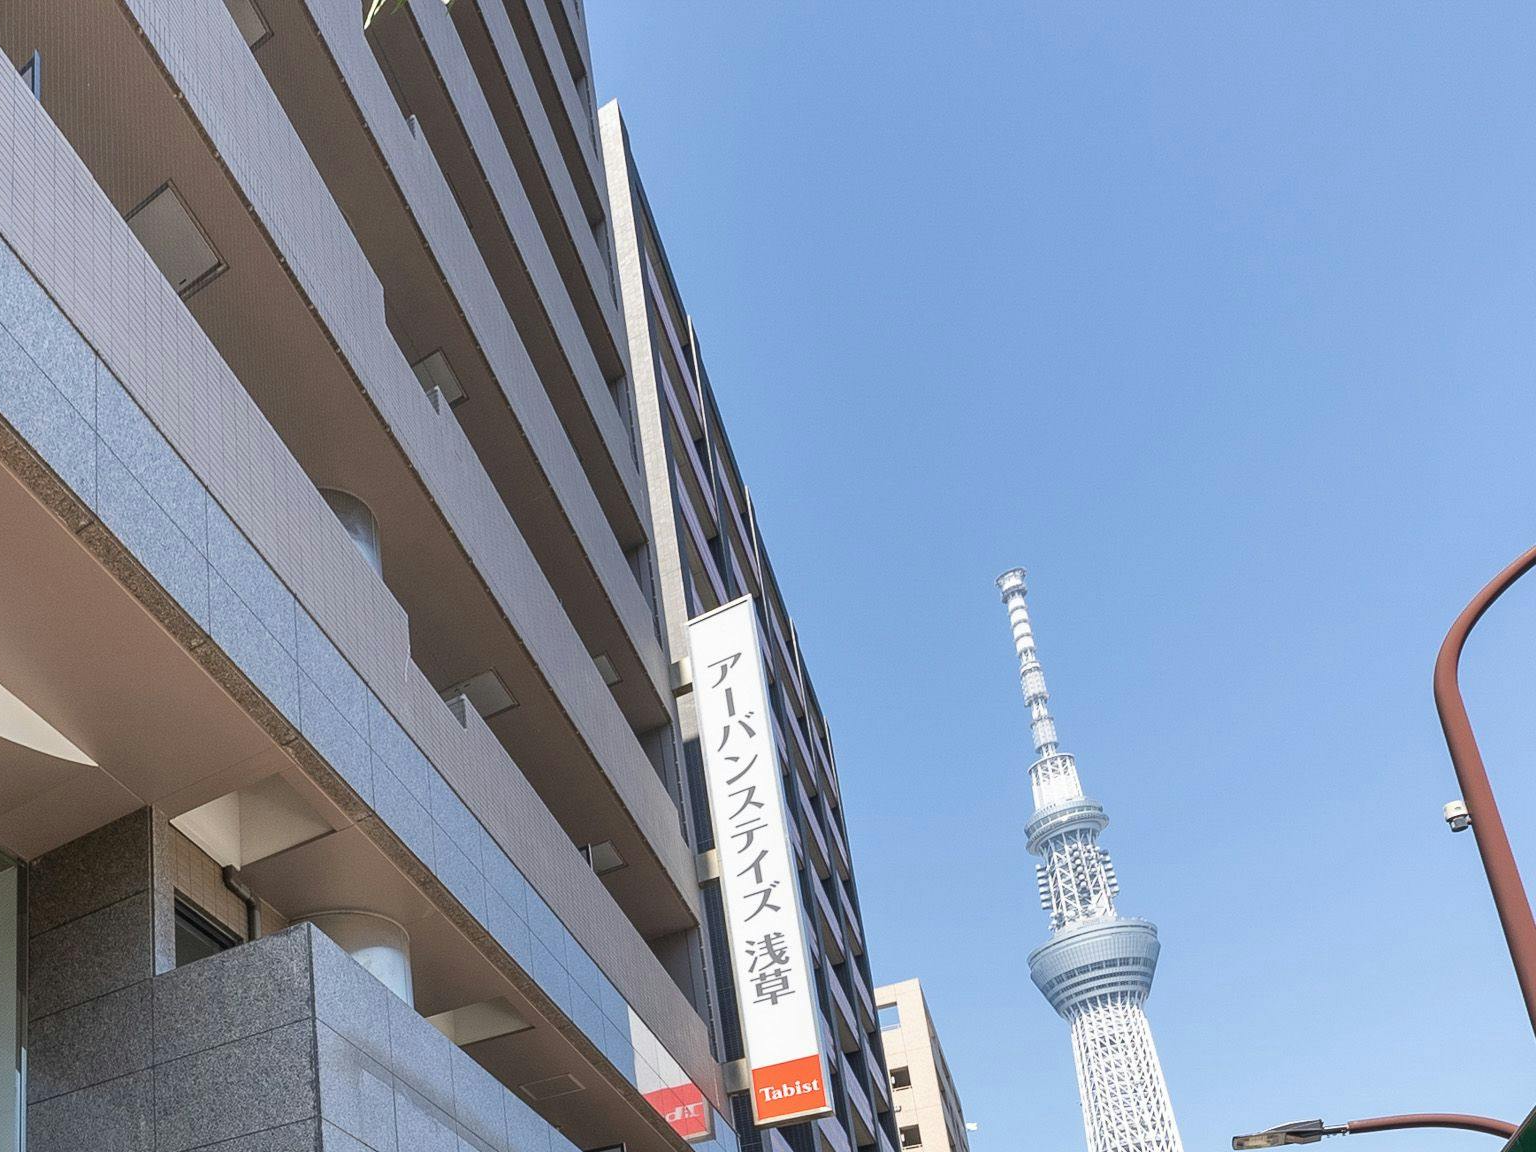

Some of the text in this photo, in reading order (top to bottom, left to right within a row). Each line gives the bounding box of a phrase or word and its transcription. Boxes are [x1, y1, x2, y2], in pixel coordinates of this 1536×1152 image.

[707, 652, 797, 1005] アーバンステイズ 浅草
[759, 1077, 820, 1103] Tabist
